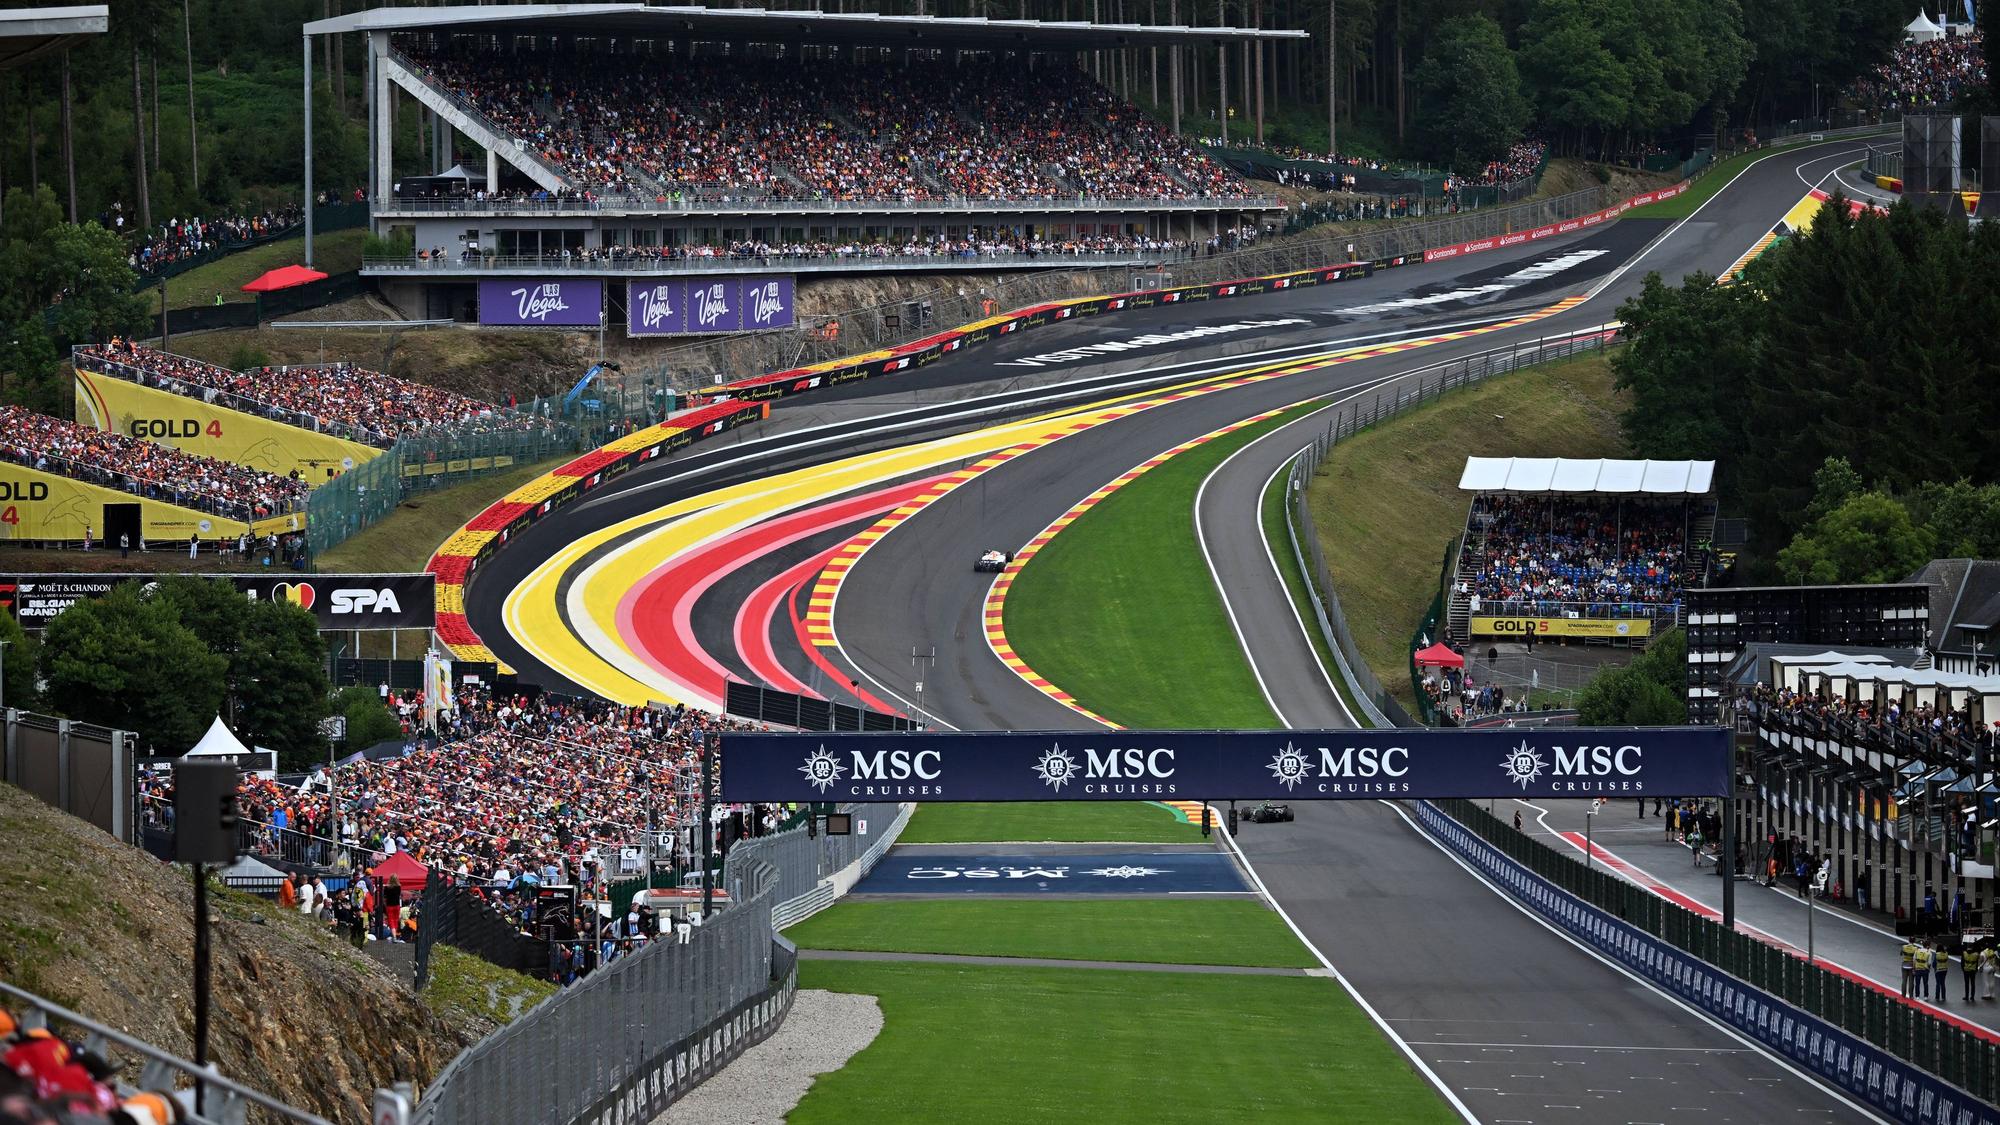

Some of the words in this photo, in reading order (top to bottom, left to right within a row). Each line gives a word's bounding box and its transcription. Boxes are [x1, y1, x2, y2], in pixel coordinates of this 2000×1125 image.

[1470, 241, 1493, 252] Santander
[1434, 248, 1458, 259] Santander
[542, 284, 560, 296] LAS
[512, 286, 569, 321] Vegas
[638, 288, 673, 328] Vegas
[695, 287, 729, 326] Vegas
[750, 285, 784, 324] Vegas
[131, 420, 200, 438] GOLD
[206, 420, 223, 438] 4
[1, 506, 19, 525] 4
[38, 583, 62, 592] MOËT
[64, 584, 69, 592] &
[70, 584, 111, 592] CHANDON
[29, 600, 74, 608] BELGIAN
[331, 588, 401, 613] SPA
[20, 608, 57, 616] GRAND
[1493, 621, 1536, 631] GOLD
[1540, 622, 1549, 631] 5
[851, 750, 941, 780] MSC
[1084, 749, 1175, 778] MSC
[1318, 747, 1409, 777] MSC
[1552, 746, 1642, 776] MSC
[851, 786, 942, 795] CRUISES
[1085, 785, 1176, 793] CRUISES
[1318, 783, 1409, 792] CRUISES
[1552, 782, 1643, 791] CRUISES
[662, 836, 670, 844] D
[907, 869, 1069, 878] MSC
